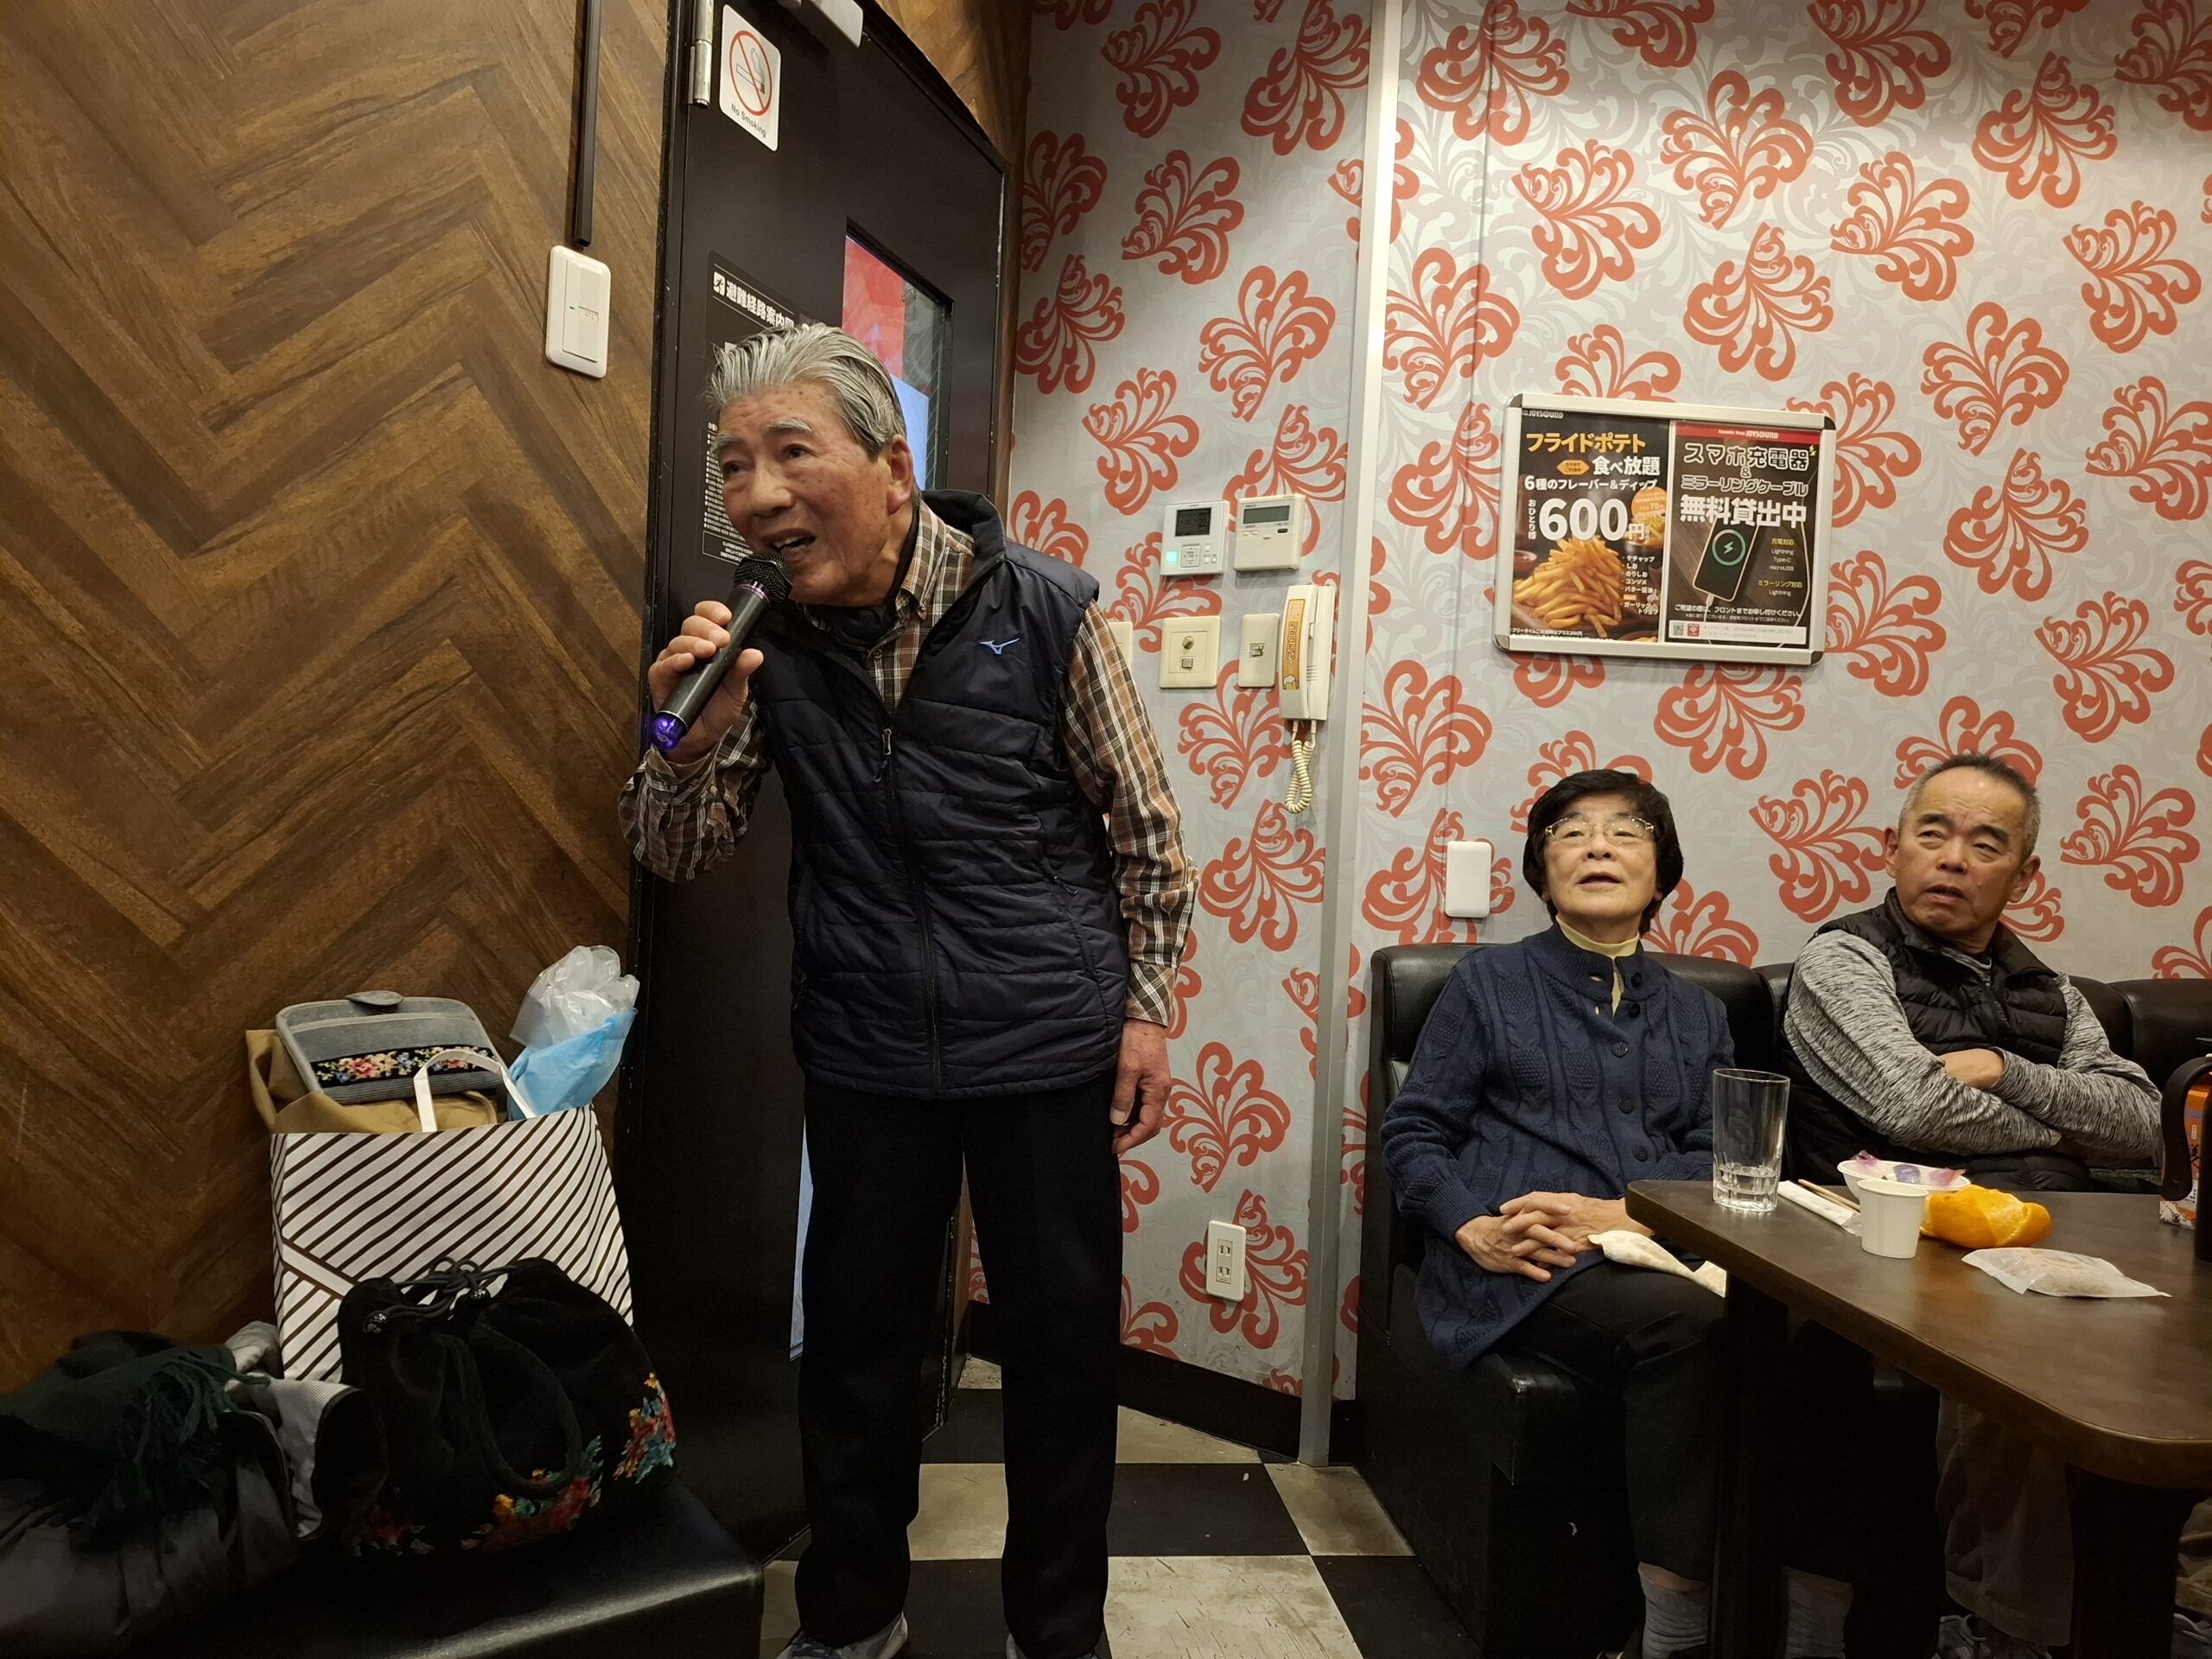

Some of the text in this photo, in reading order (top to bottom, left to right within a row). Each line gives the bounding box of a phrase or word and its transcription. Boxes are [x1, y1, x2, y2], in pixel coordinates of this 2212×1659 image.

[730, 102, 767, 138] No Smoking
[1528, 410, 1564, 419] JOYSOUND
[1526, 431, 1646, 454] フライドポテト
[1745, 430, 1779, 439] JOYSOUND
[1592, 455, 1661, 476] 食べ放題
[1683, 442, 1809, 471] スマホ充電器
[1740, 465, 1751, 478] &
[1681, 474, 1809, 497] ミラーリングケーブル
[1528, 499, 1537, 540] おひとり様
[1680, 493, 1808, 529] 無料貸出中
